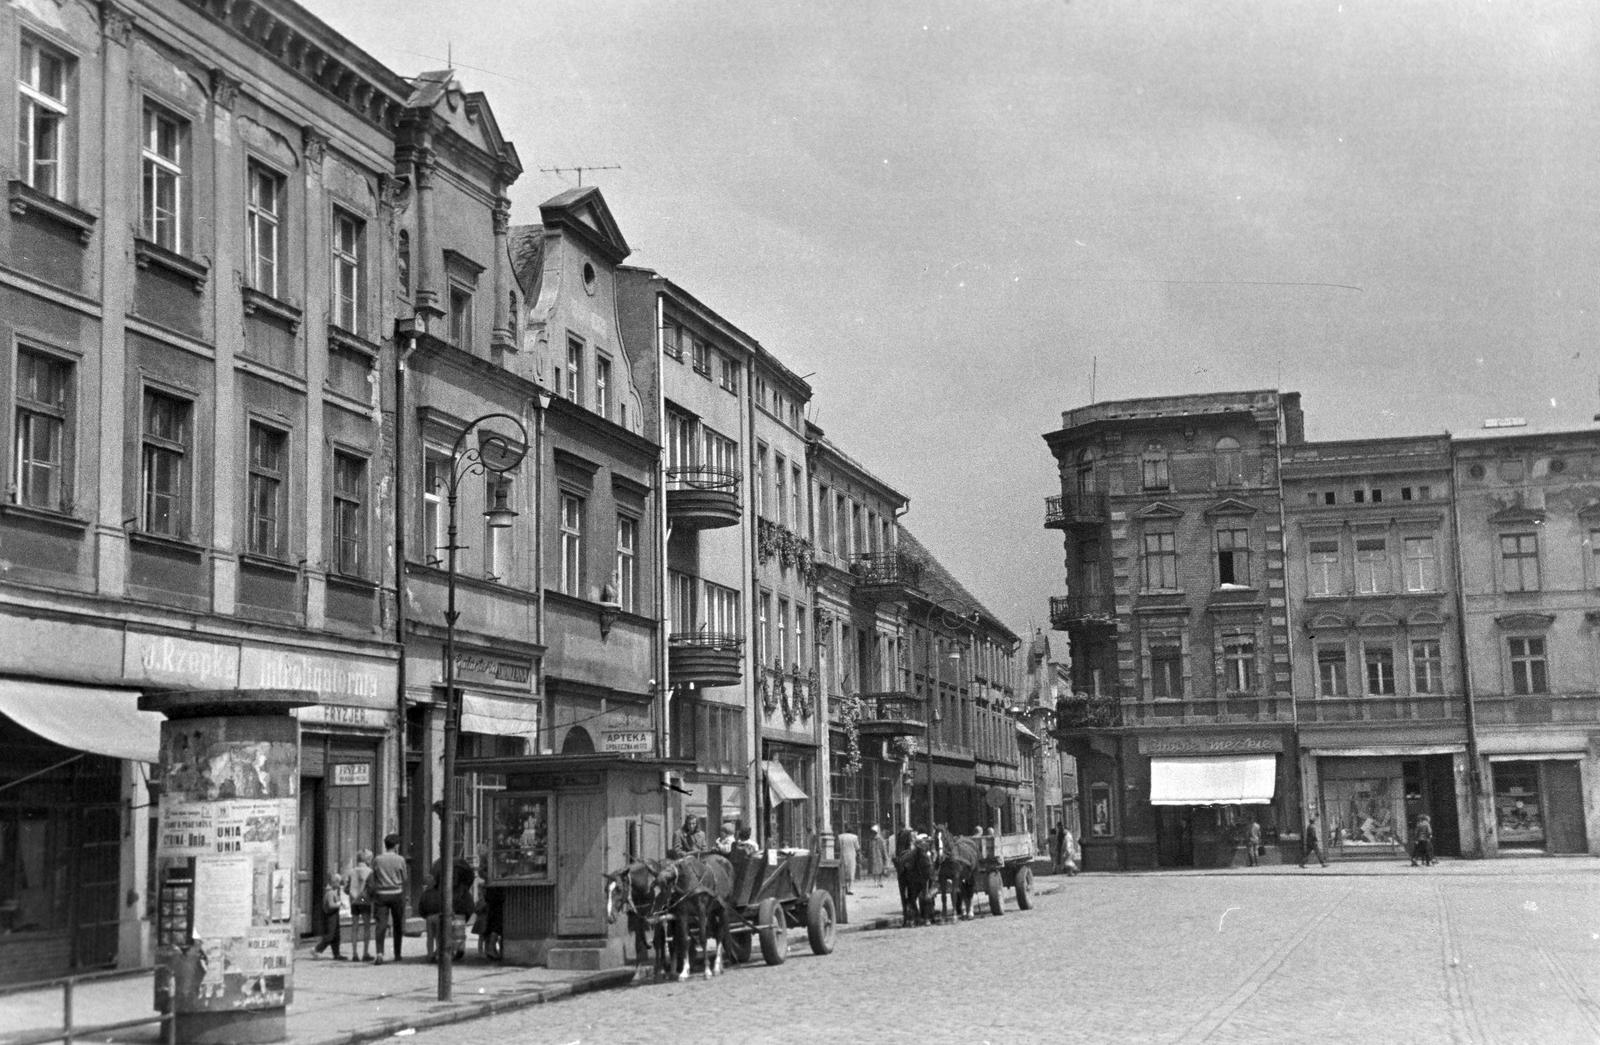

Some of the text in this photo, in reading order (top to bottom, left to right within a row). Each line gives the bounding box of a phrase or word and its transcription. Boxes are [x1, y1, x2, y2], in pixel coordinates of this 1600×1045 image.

[607, 733, 646, 741] APTEKA
[217, 826, 241, 838] UNIA
[217, 841, 241, 852] UNIA
